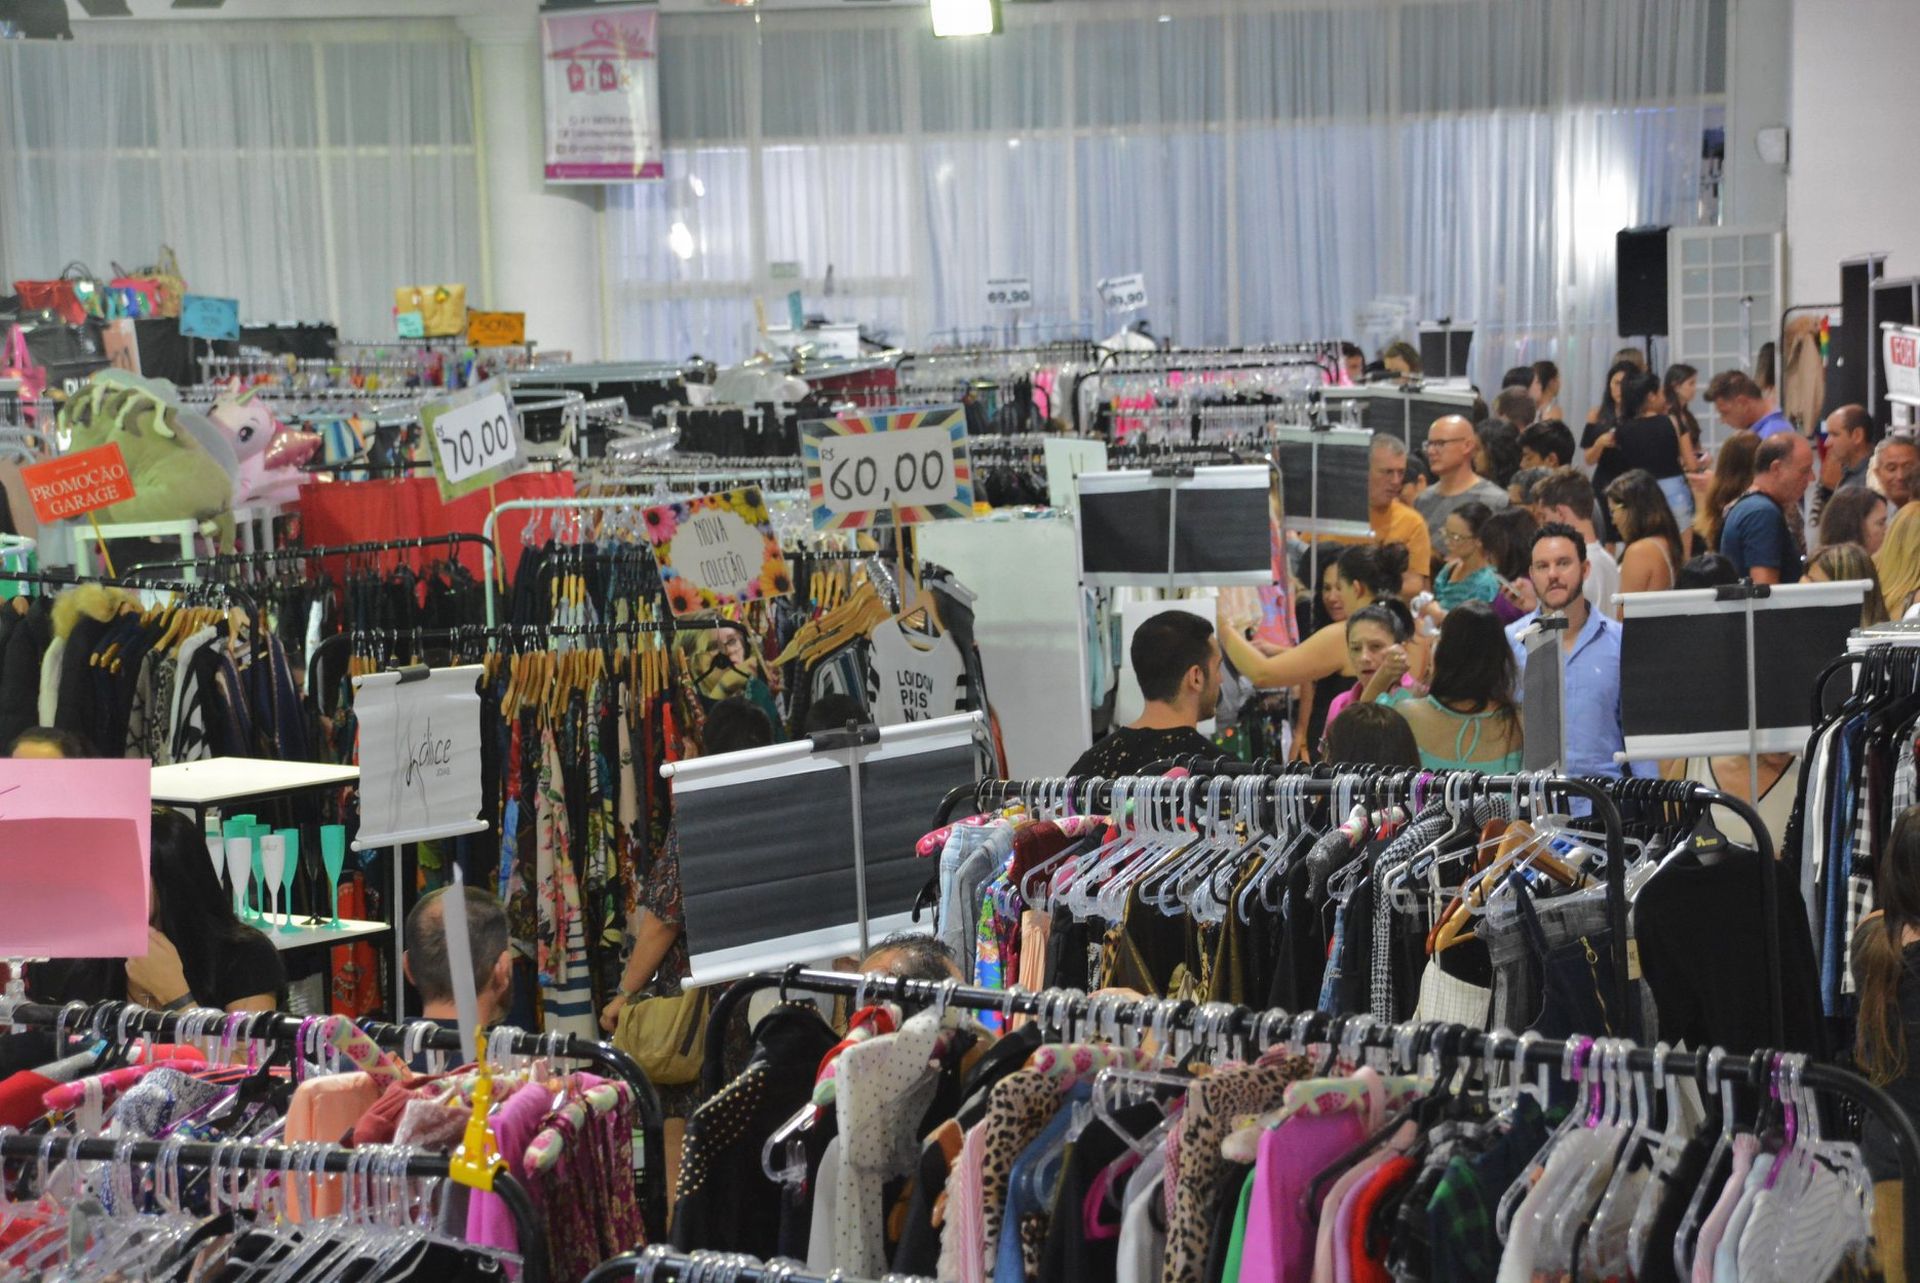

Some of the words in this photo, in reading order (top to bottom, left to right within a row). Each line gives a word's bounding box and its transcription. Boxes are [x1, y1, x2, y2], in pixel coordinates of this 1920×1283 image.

[442, 415, 508, 474] 70,00
[830, 450, 944, 501] 60,00
[50, 485, 119, 515] GARAGE
[693, 514, 729, 546] NOVA
[700, 551, 747, 588] COLEÇÃO
